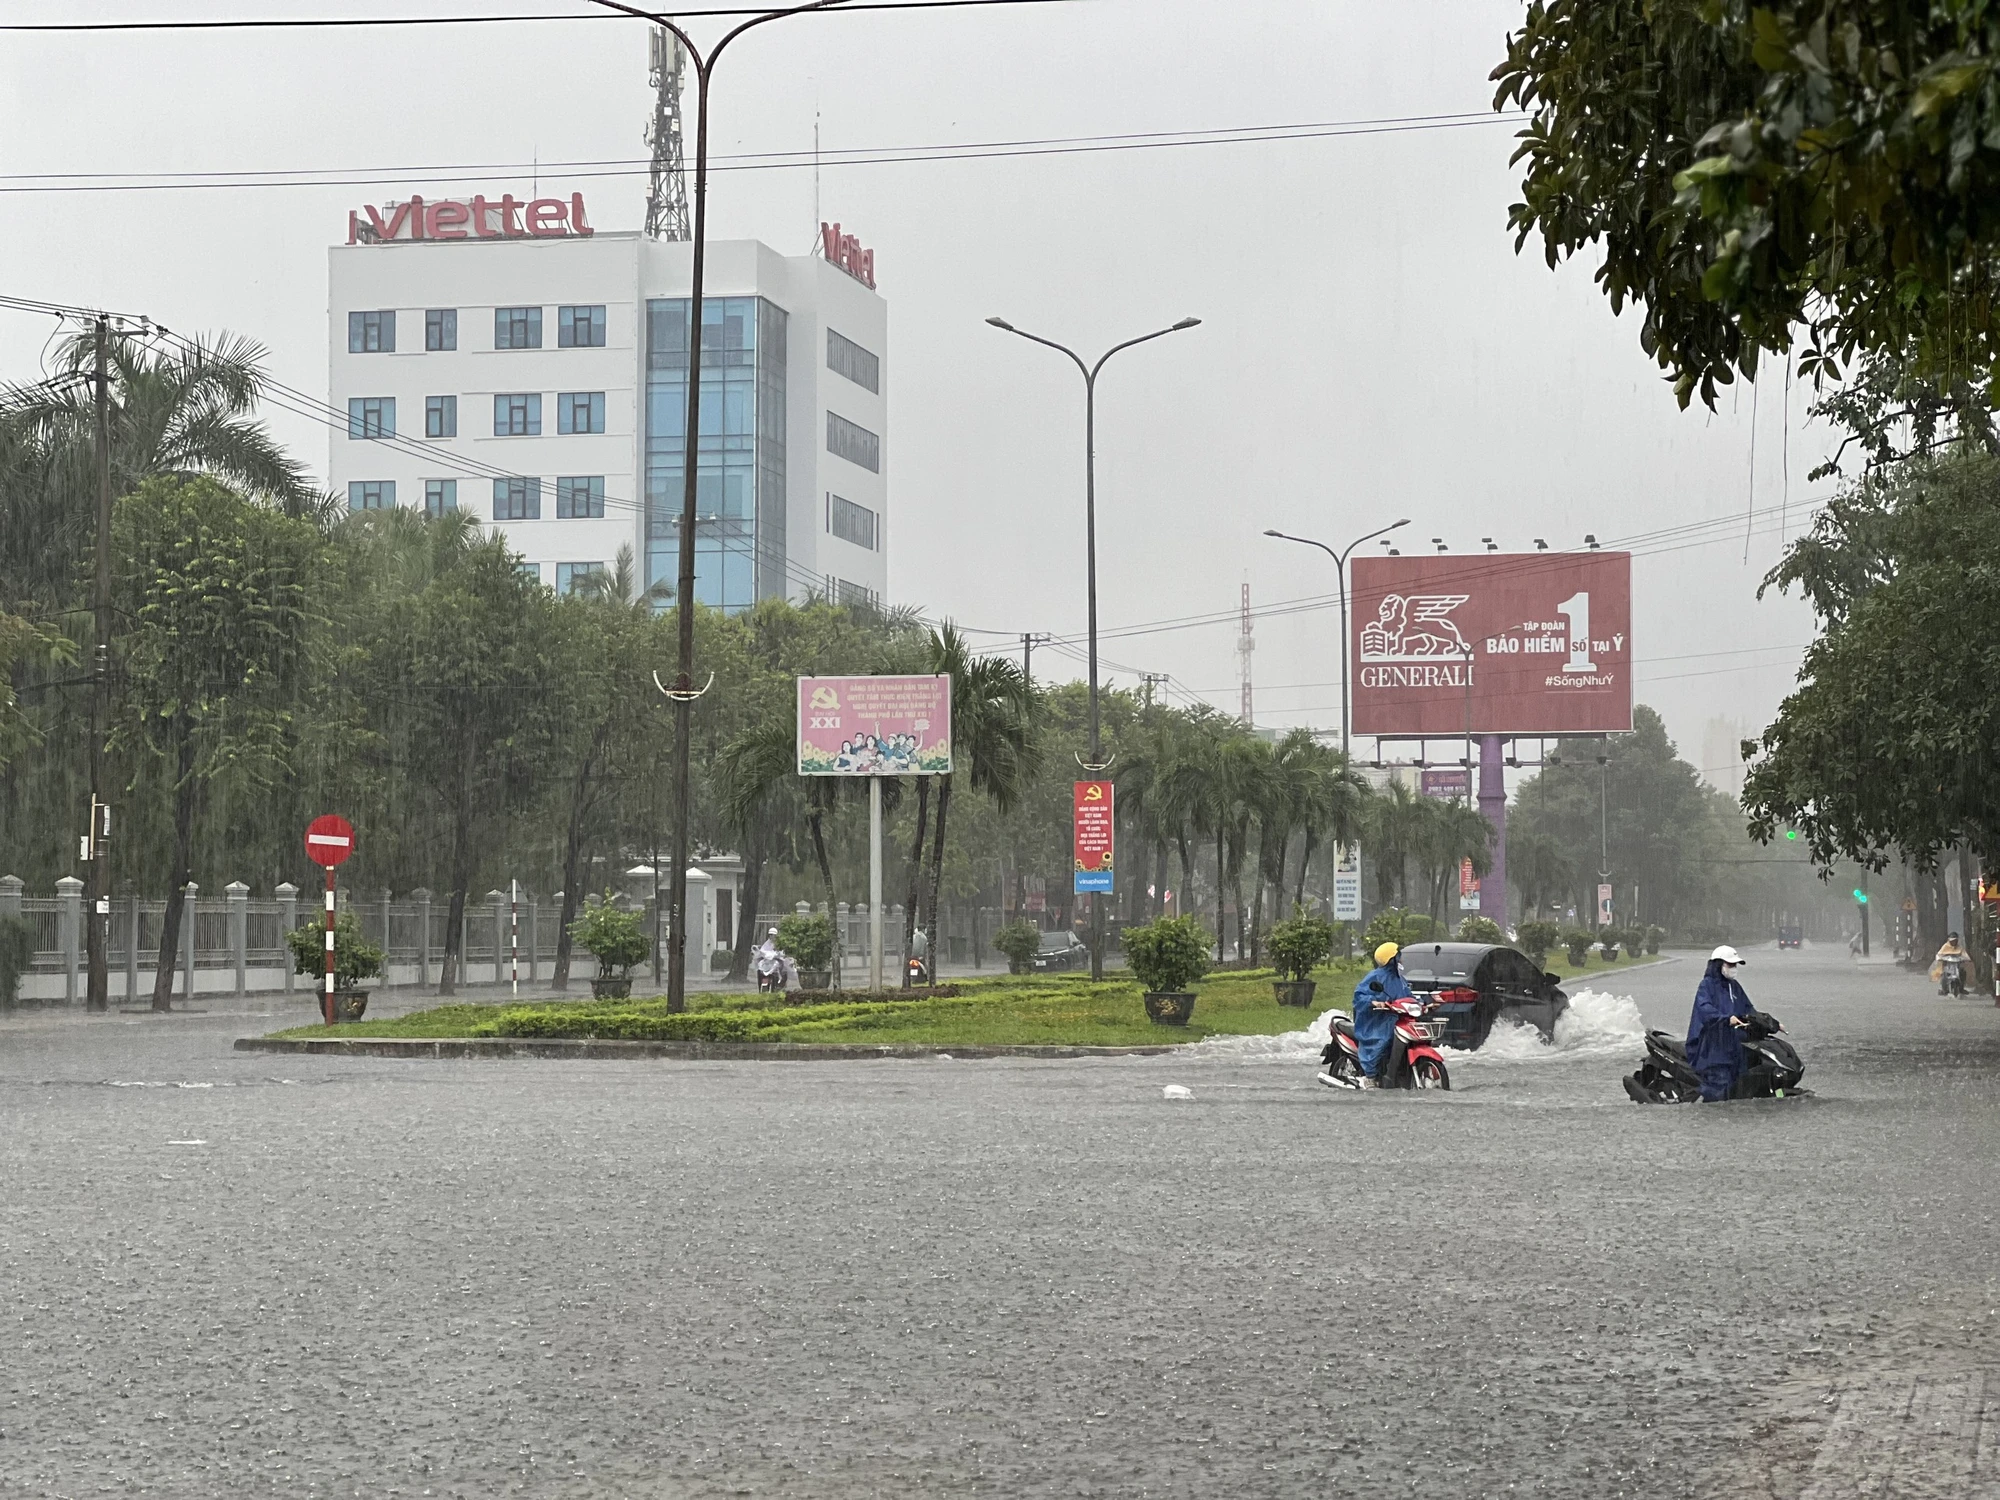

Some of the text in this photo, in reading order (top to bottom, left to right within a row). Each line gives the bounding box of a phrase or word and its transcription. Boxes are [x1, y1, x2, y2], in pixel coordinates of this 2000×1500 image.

[363, 192, 594, 239] viettel
[1523, 621, 1565, 632] TẬP ĐOÀN
[1557, 592, 1597, 672] 1
[1487, 632, 1624, 654] BẢO HIỂM SỐ TẠI Ý
[1360, 665, 1474, 688] GENERALI
[809, 717, 841, 729] XXI
